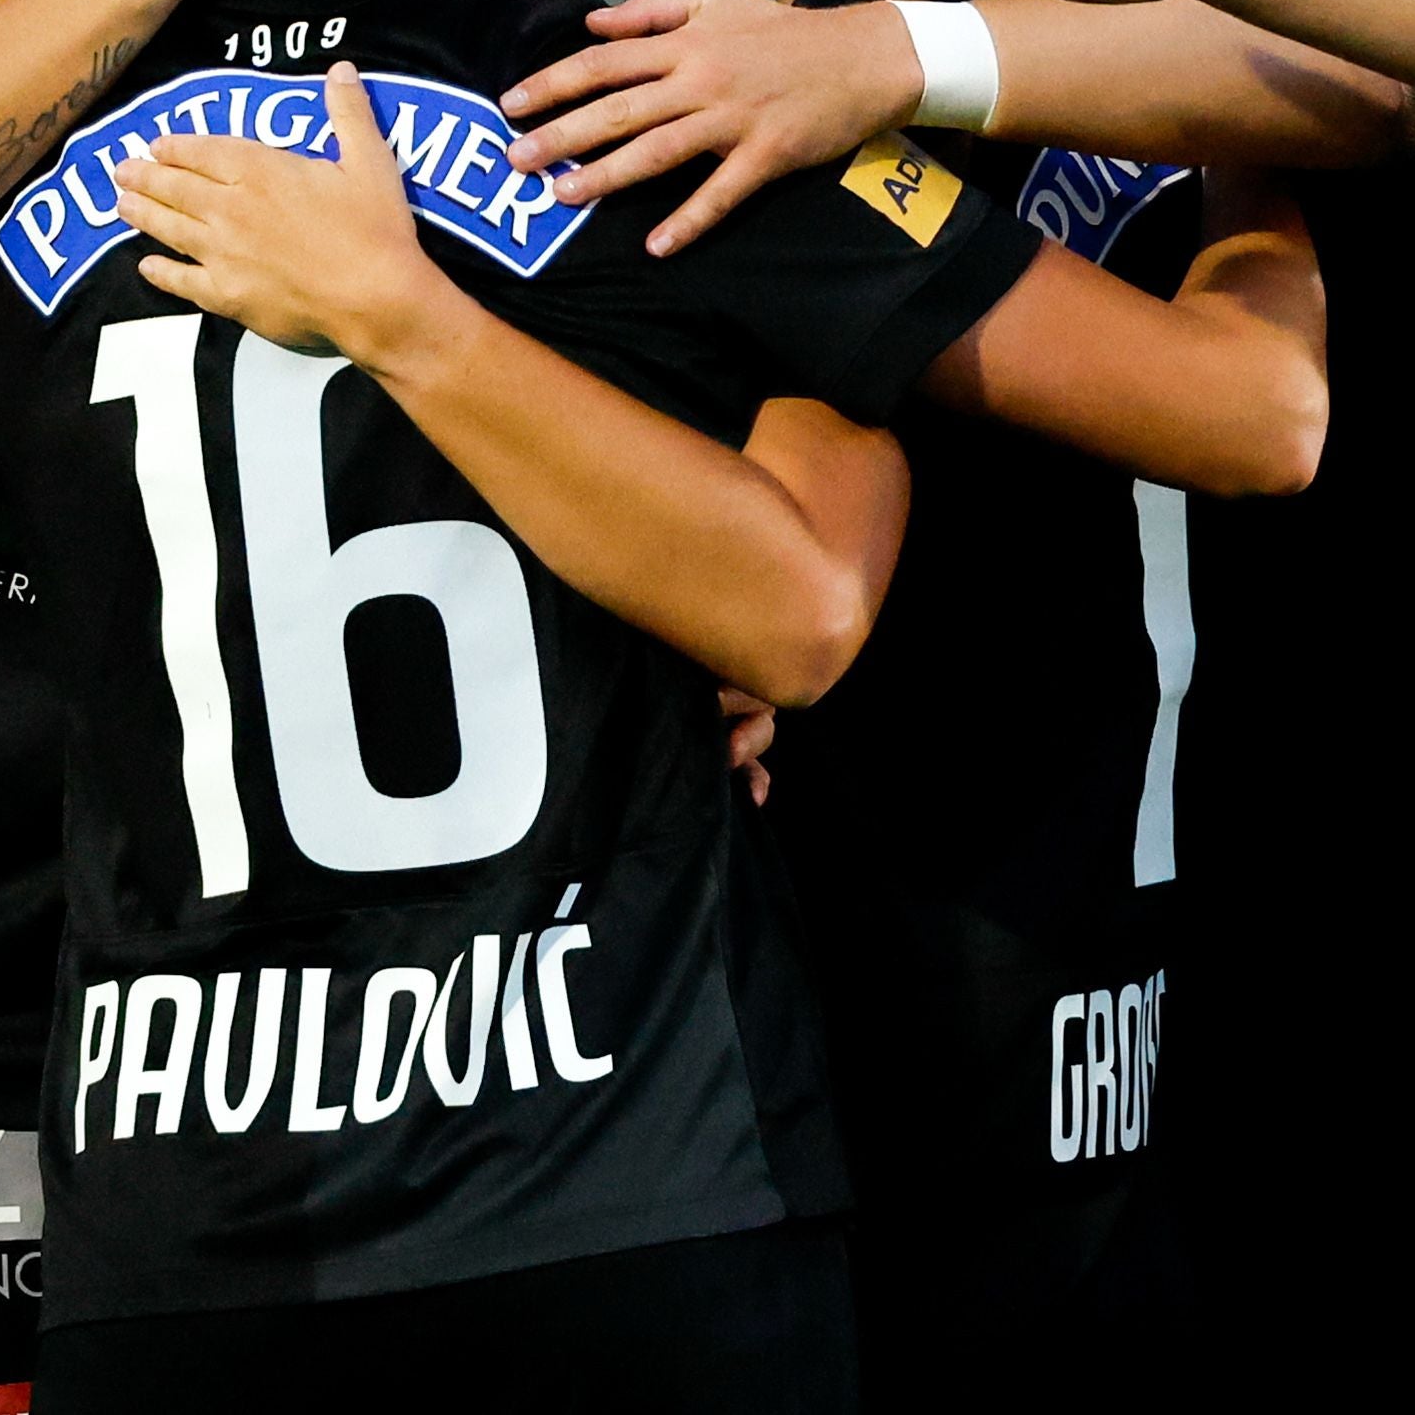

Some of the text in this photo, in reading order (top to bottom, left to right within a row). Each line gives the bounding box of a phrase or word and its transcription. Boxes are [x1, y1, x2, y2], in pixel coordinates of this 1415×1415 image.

[225, 18, 347, 67] 1909
[14, 87, 557, 278] PUNTIGMER
[90, 313, 548, 899] 16
[74, 883, 613, 1155] PAVLOVIĆ
[1051, 968, 1166, 1163] GRO
